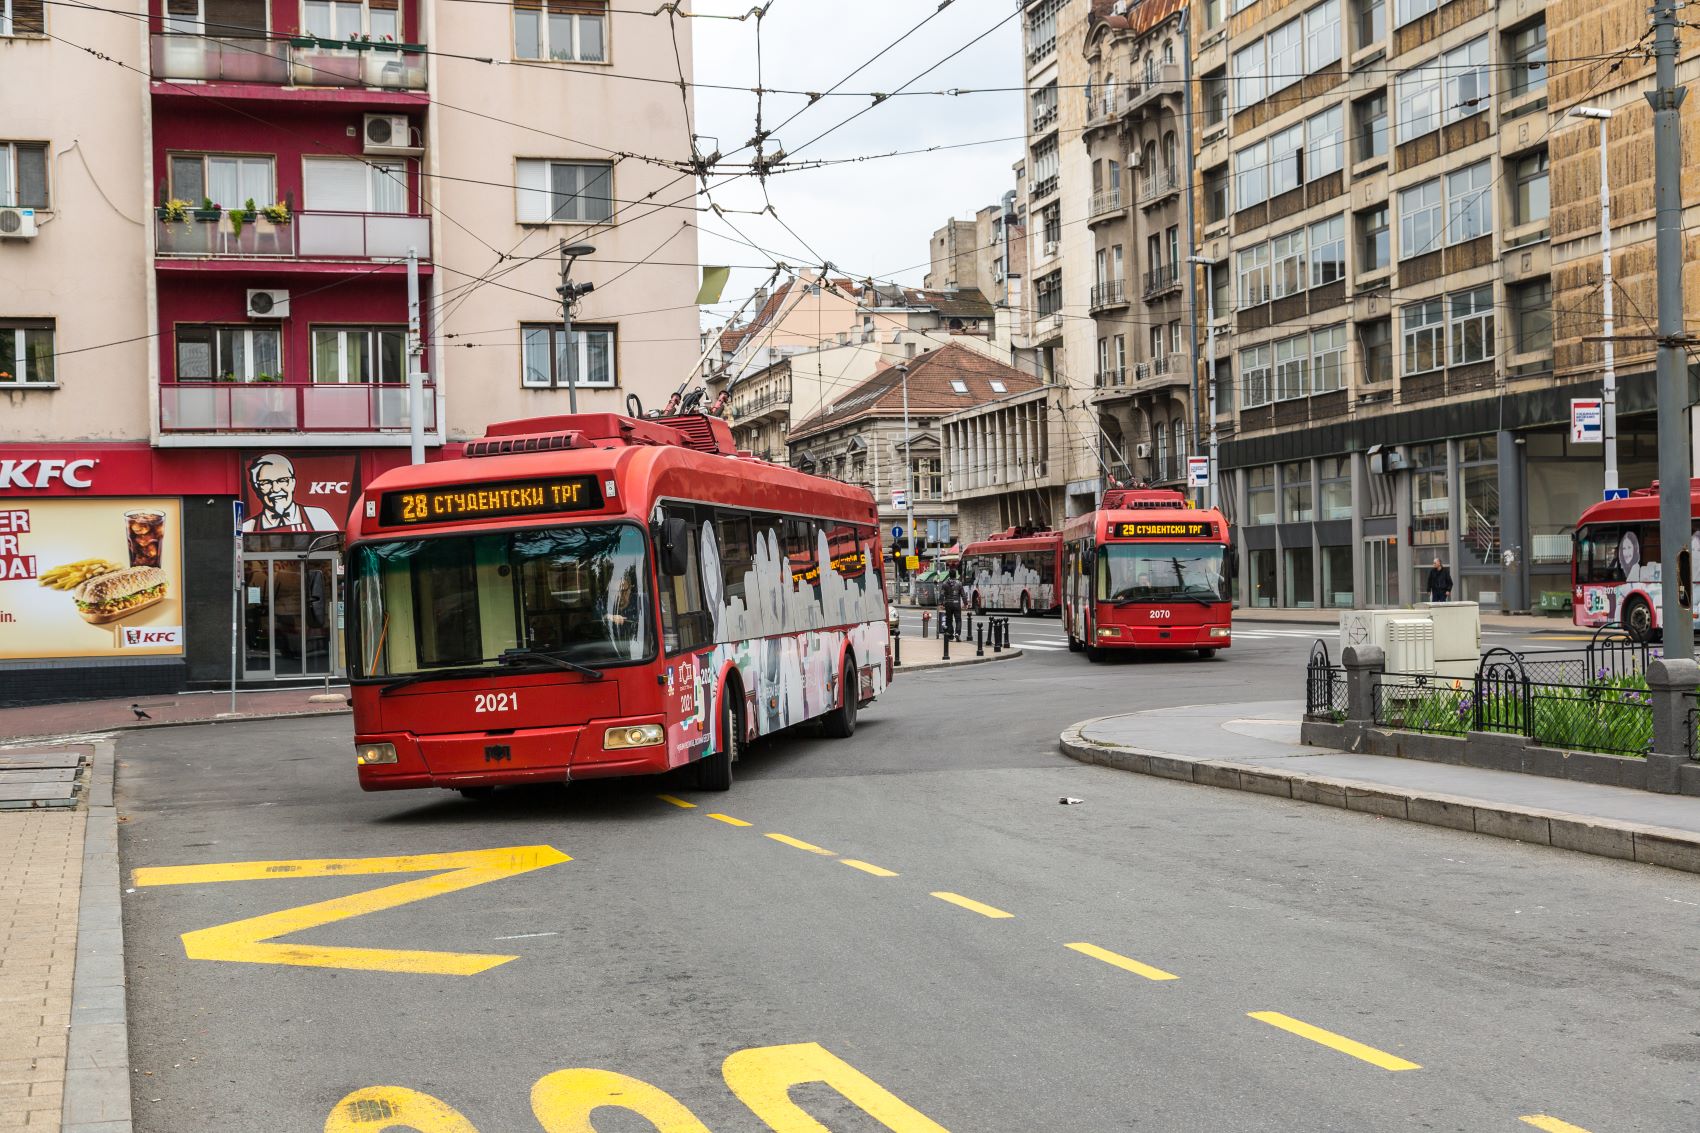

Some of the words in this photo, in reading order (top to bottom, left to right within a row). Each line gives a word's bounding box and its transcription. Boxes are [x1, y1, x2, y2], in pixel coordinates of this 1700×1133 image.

[0, 459, 94, 488] KFC
[308, 481, 350, 495] KFC
[402, 494, 428, 519] 28
[433, 487, 544, 514] СТУДЕНТСКИ
[551, 484, 582, 504] ТРГ
[1122, 524, 1135, 535] 29
[1136, 525, 1186, 534] СТУДЕНТСКИ
[1188, 525, 1203, 534] ТРГ
[1149, 609, 1171, 619] 2070
[143, 632, 176, 643] KFC
[474, 691, 518, 713] 2021
[680, 693, 693, 713] 2021
